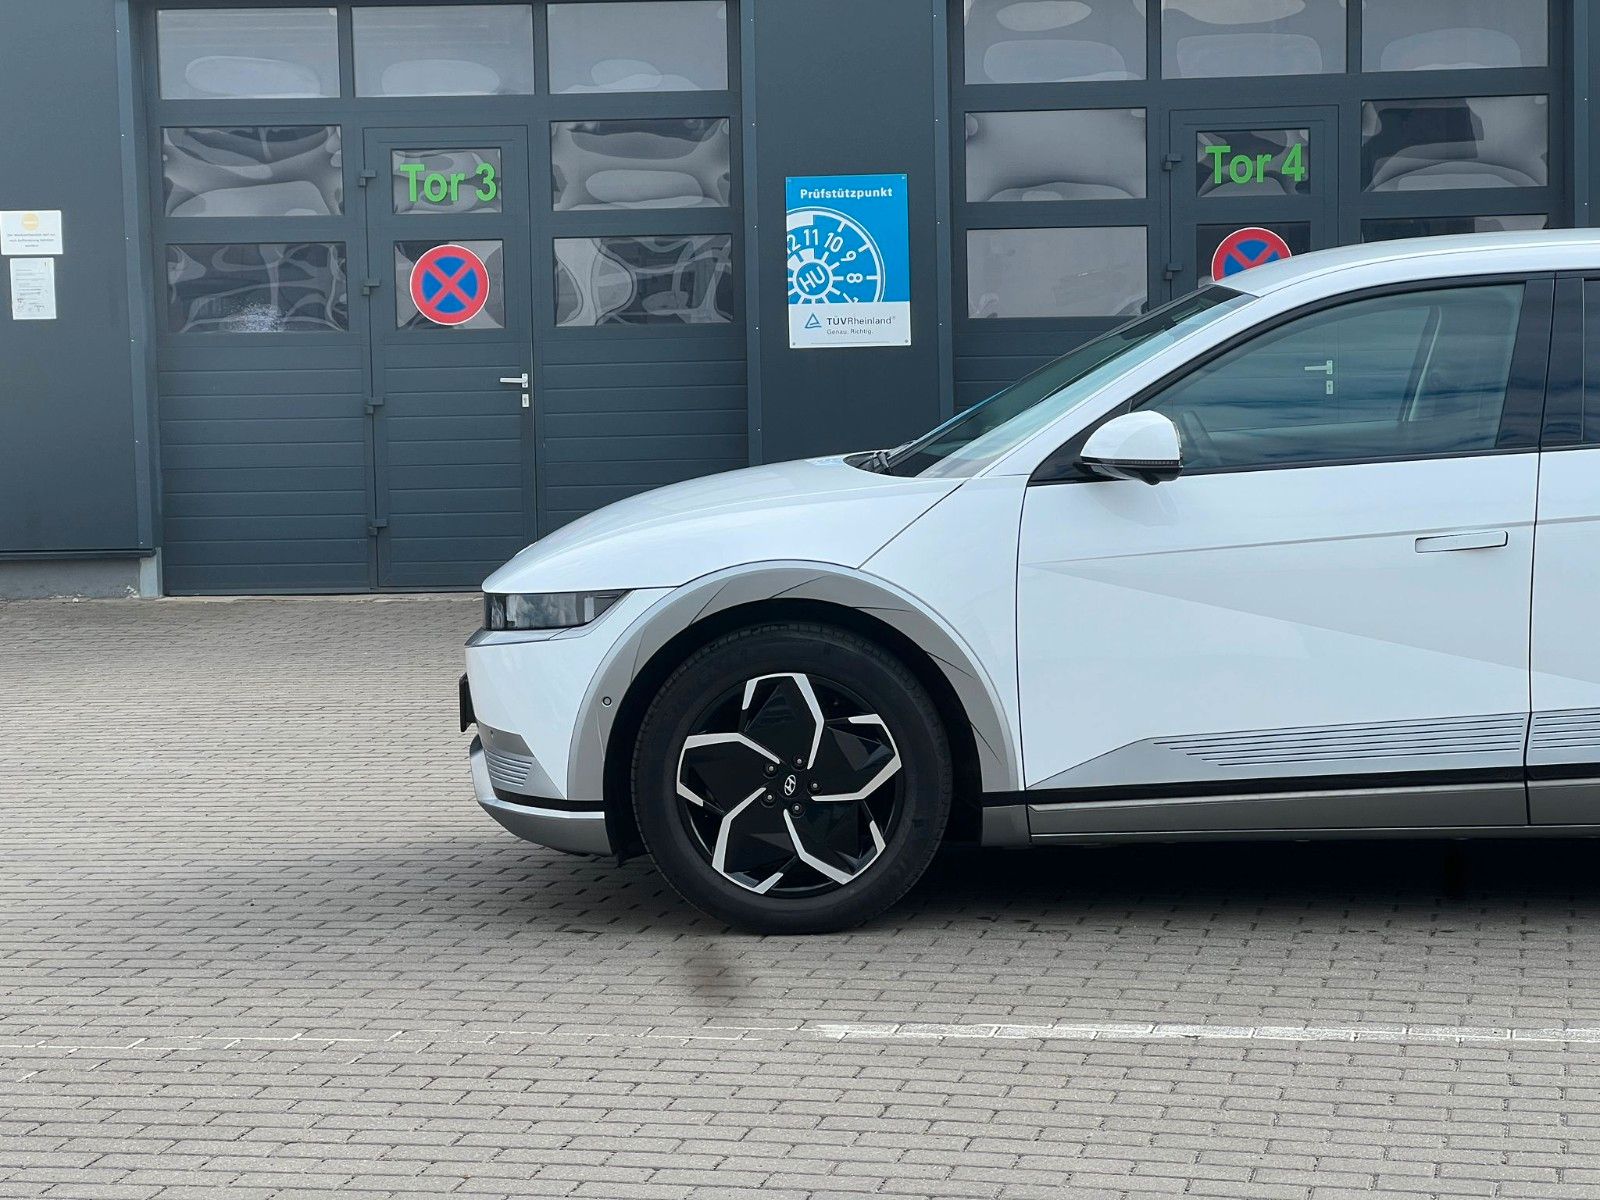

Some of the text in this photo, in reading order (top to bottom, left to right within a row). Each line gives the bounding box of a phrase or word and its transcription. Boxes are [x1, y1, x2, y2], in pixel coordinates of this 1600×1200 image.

[1205, 142, 1305, 184] Tor 4
[400, 162, 497, 202] Tor 3
[800, 187, 893, 200] Prüfstützpunkt
[787, 234, 801, 254] 2
[803, 228, 819, 246] 11
[824, 232, 844, 252] 10
[840, 250, 857, 262] 9
[798, 265, 826, 292] HU
[846, 272, 863, 283] 8
